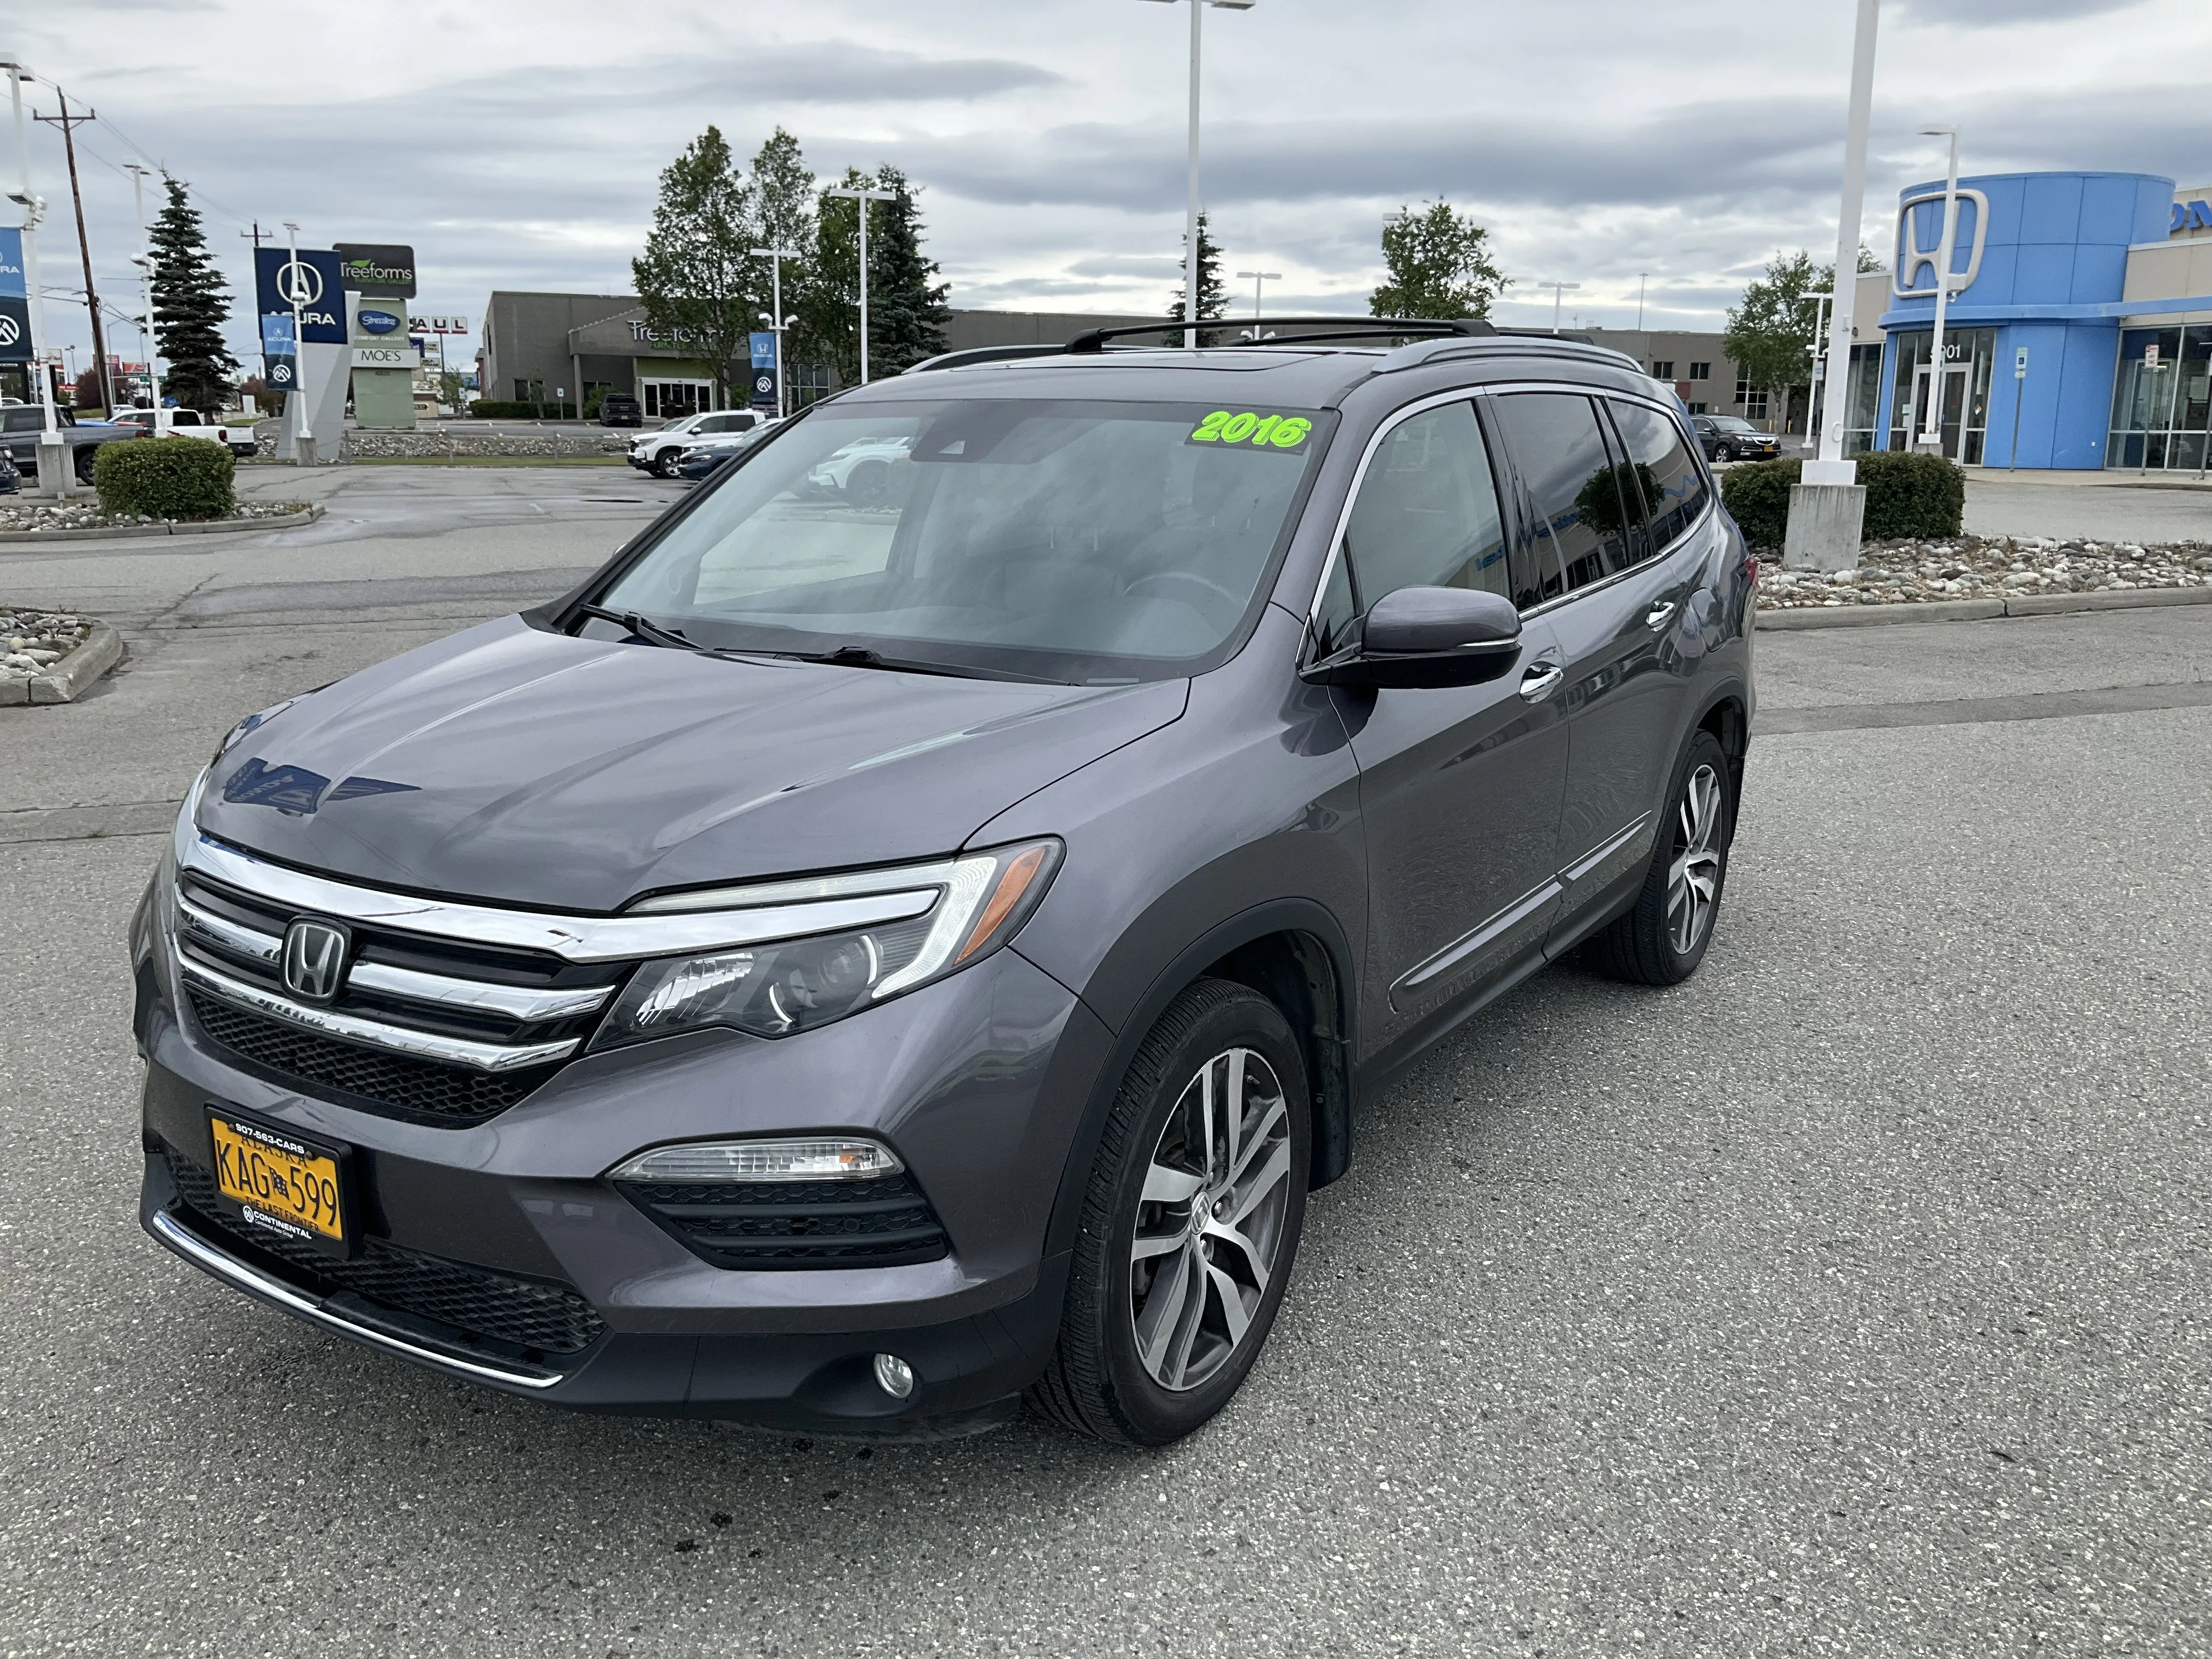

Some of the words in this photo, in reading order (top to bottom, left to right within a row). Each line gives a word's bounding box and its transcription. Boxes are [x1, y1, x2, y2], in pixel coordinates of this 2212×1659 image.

[340, 262, 413, 279] Treeforms
[270, 311, 336, 325] URA
[362, 315, 396, 325] Stressless
[361, 350, 401, 362] MOE'S
[1191, 411, 1312, 447] 2016
[235, 1123, 304, 1154] 907-563-CARS
[216, 1138, 270, 1199] KAG
[290, 1165, 337, 1227] 599
[246, 1196, 261, 1206] THE
[263, 1201, 283, 1217] LAST
[285, 1209, 318, 1230] FRONTIER
[253, 1210, 312, 1239] CONTINENTAL
